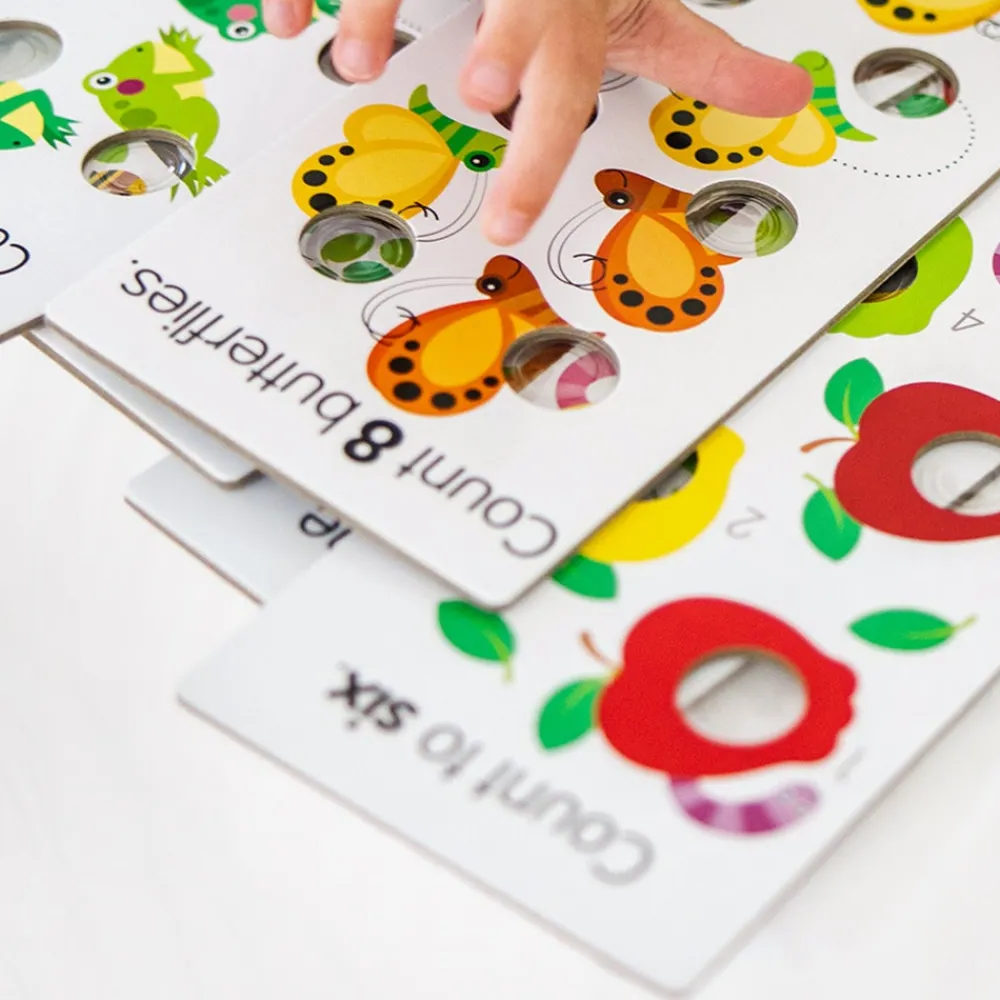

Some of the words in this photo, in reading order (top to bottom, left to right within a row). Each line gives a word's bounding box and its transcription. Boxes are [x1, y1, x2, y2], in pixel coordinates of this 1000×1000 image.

[118, 257, 362, 436] butterflies.
[951, 307, 985, 334] 4
[343, 418, 405, 467] 8
[397, 445, 559, 561] Count
[726, 505, 767, 541] 2
[327, 665, 418, 736] six
[417, 720, 484, 782] to
[475, 757, 656, 887] Count
